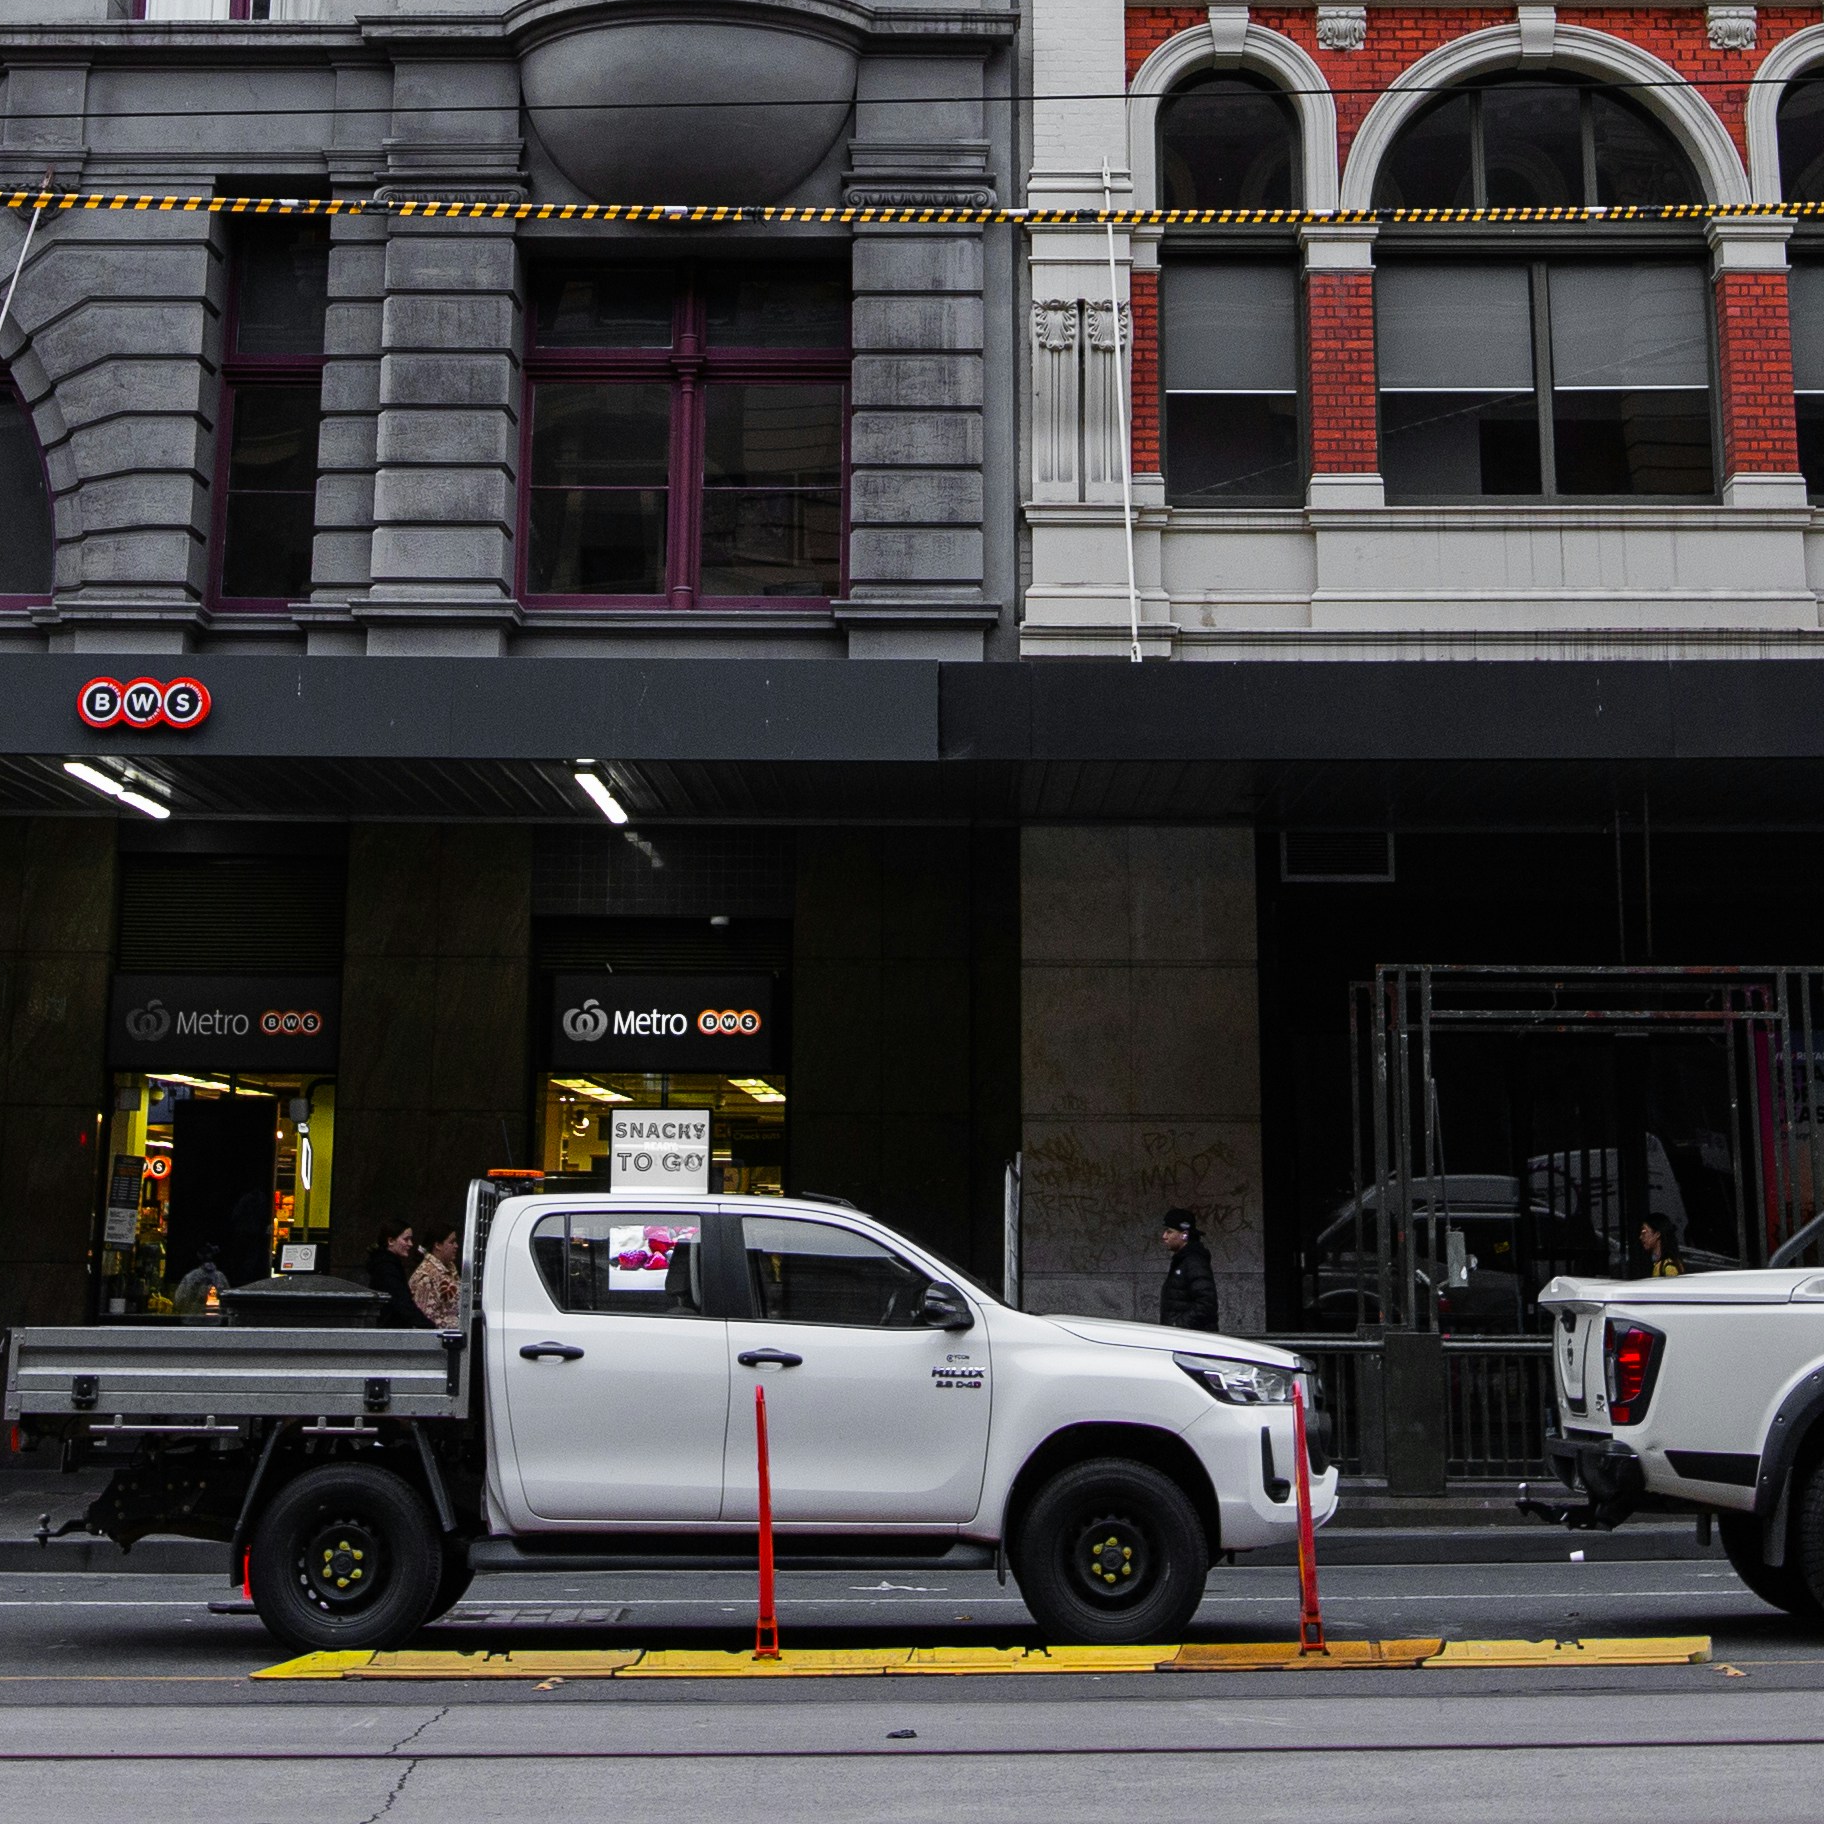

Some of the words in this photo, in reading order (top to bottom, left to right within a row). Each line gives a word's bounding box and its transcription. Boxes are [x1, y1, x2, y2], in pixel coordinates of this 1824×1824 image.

[176, 1009, 249, 1036] Metro
[613, 1009, 688, 1036] Metro
[617, 1152, 653, 1172] TO
[932, 1366, 986, 1379] HILUX
